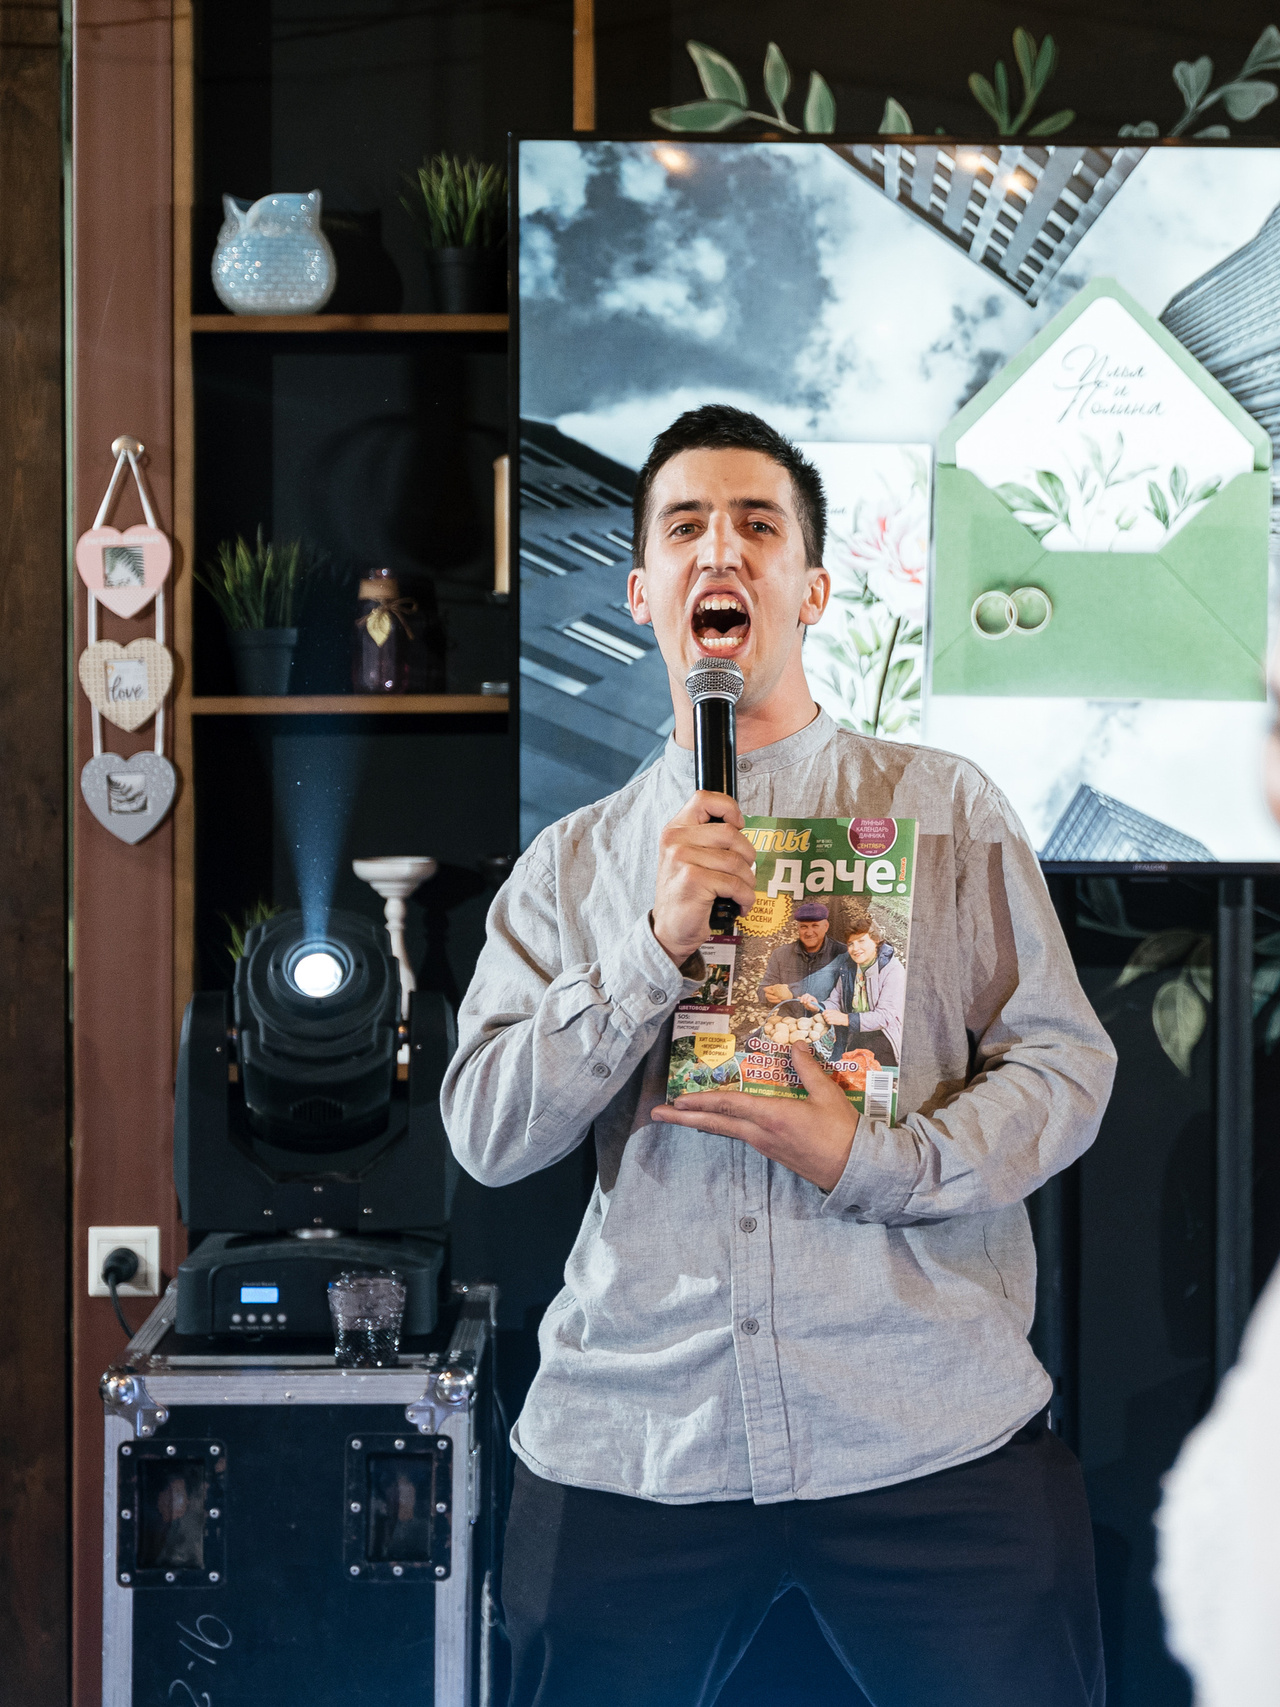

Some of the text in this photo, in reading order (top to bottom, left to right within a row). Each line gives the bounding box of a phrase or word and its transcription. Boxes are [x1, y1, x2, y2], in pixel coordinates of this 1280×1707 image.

[111, 675, 144, 702] love
[750, 914, 773, 923] ОСЕНИ
[748, 1036, 815, 1056] Форма
[758, 1089, 798, 1098] ПОДПИСАЛИСЬ
